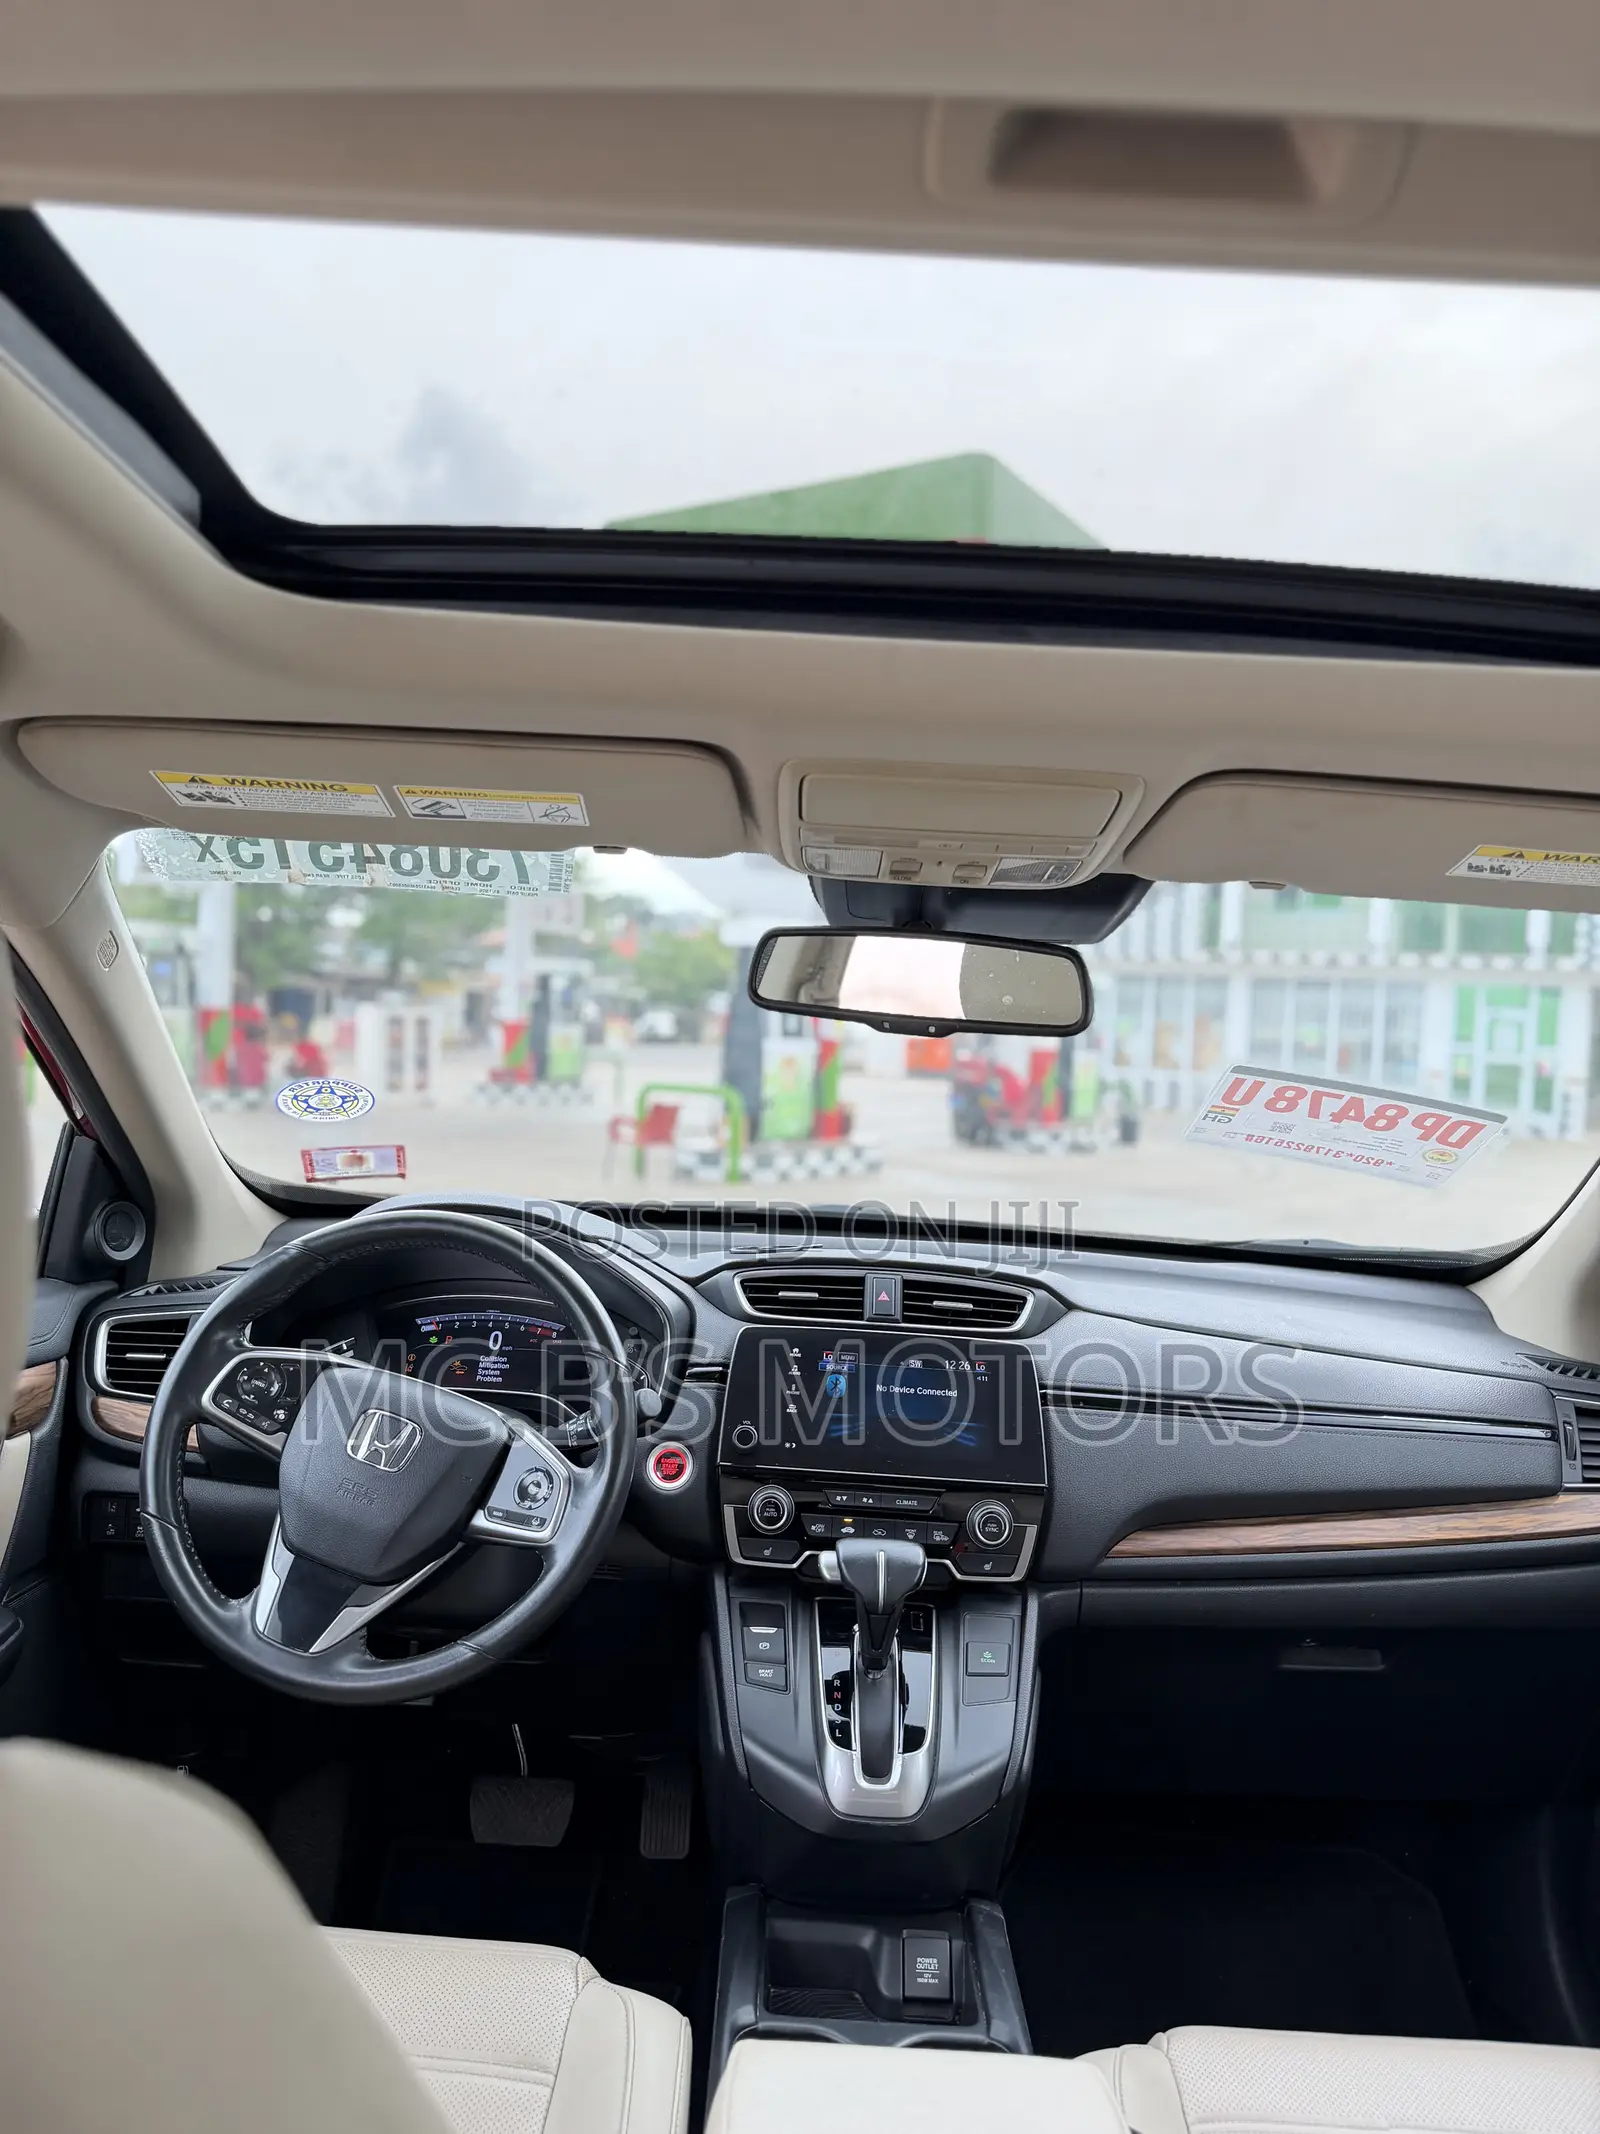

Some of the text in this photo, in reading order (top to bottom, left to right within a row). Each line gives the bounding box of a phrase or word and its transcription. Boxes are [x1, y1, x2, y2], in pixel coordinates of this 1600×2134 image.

[223, 777, 349, 792] WARNING
[419, 789, 488, 798] WARNING
[488, 1330, 503, 1351] 0
[480, 1355, 508, 1363] Collision
[823, 1352, 833, 1360] Lo
[478, 1362, 510, 1370] Mitigation
[975, 1362, 986, 1371] Lo
[477, 1369, 500, 1377] System
[476, 1375, 503, 1383] Problem
[876, 1384, 958, 1398] No Device Connected
[340, 1477, 379, 1499] SRS
[833, 1679, 841, 1687] R
[833, 1691, 842, 1699] N
[834, 1703, 842, 1711] D
[835, 1728, 842, 1737] L
